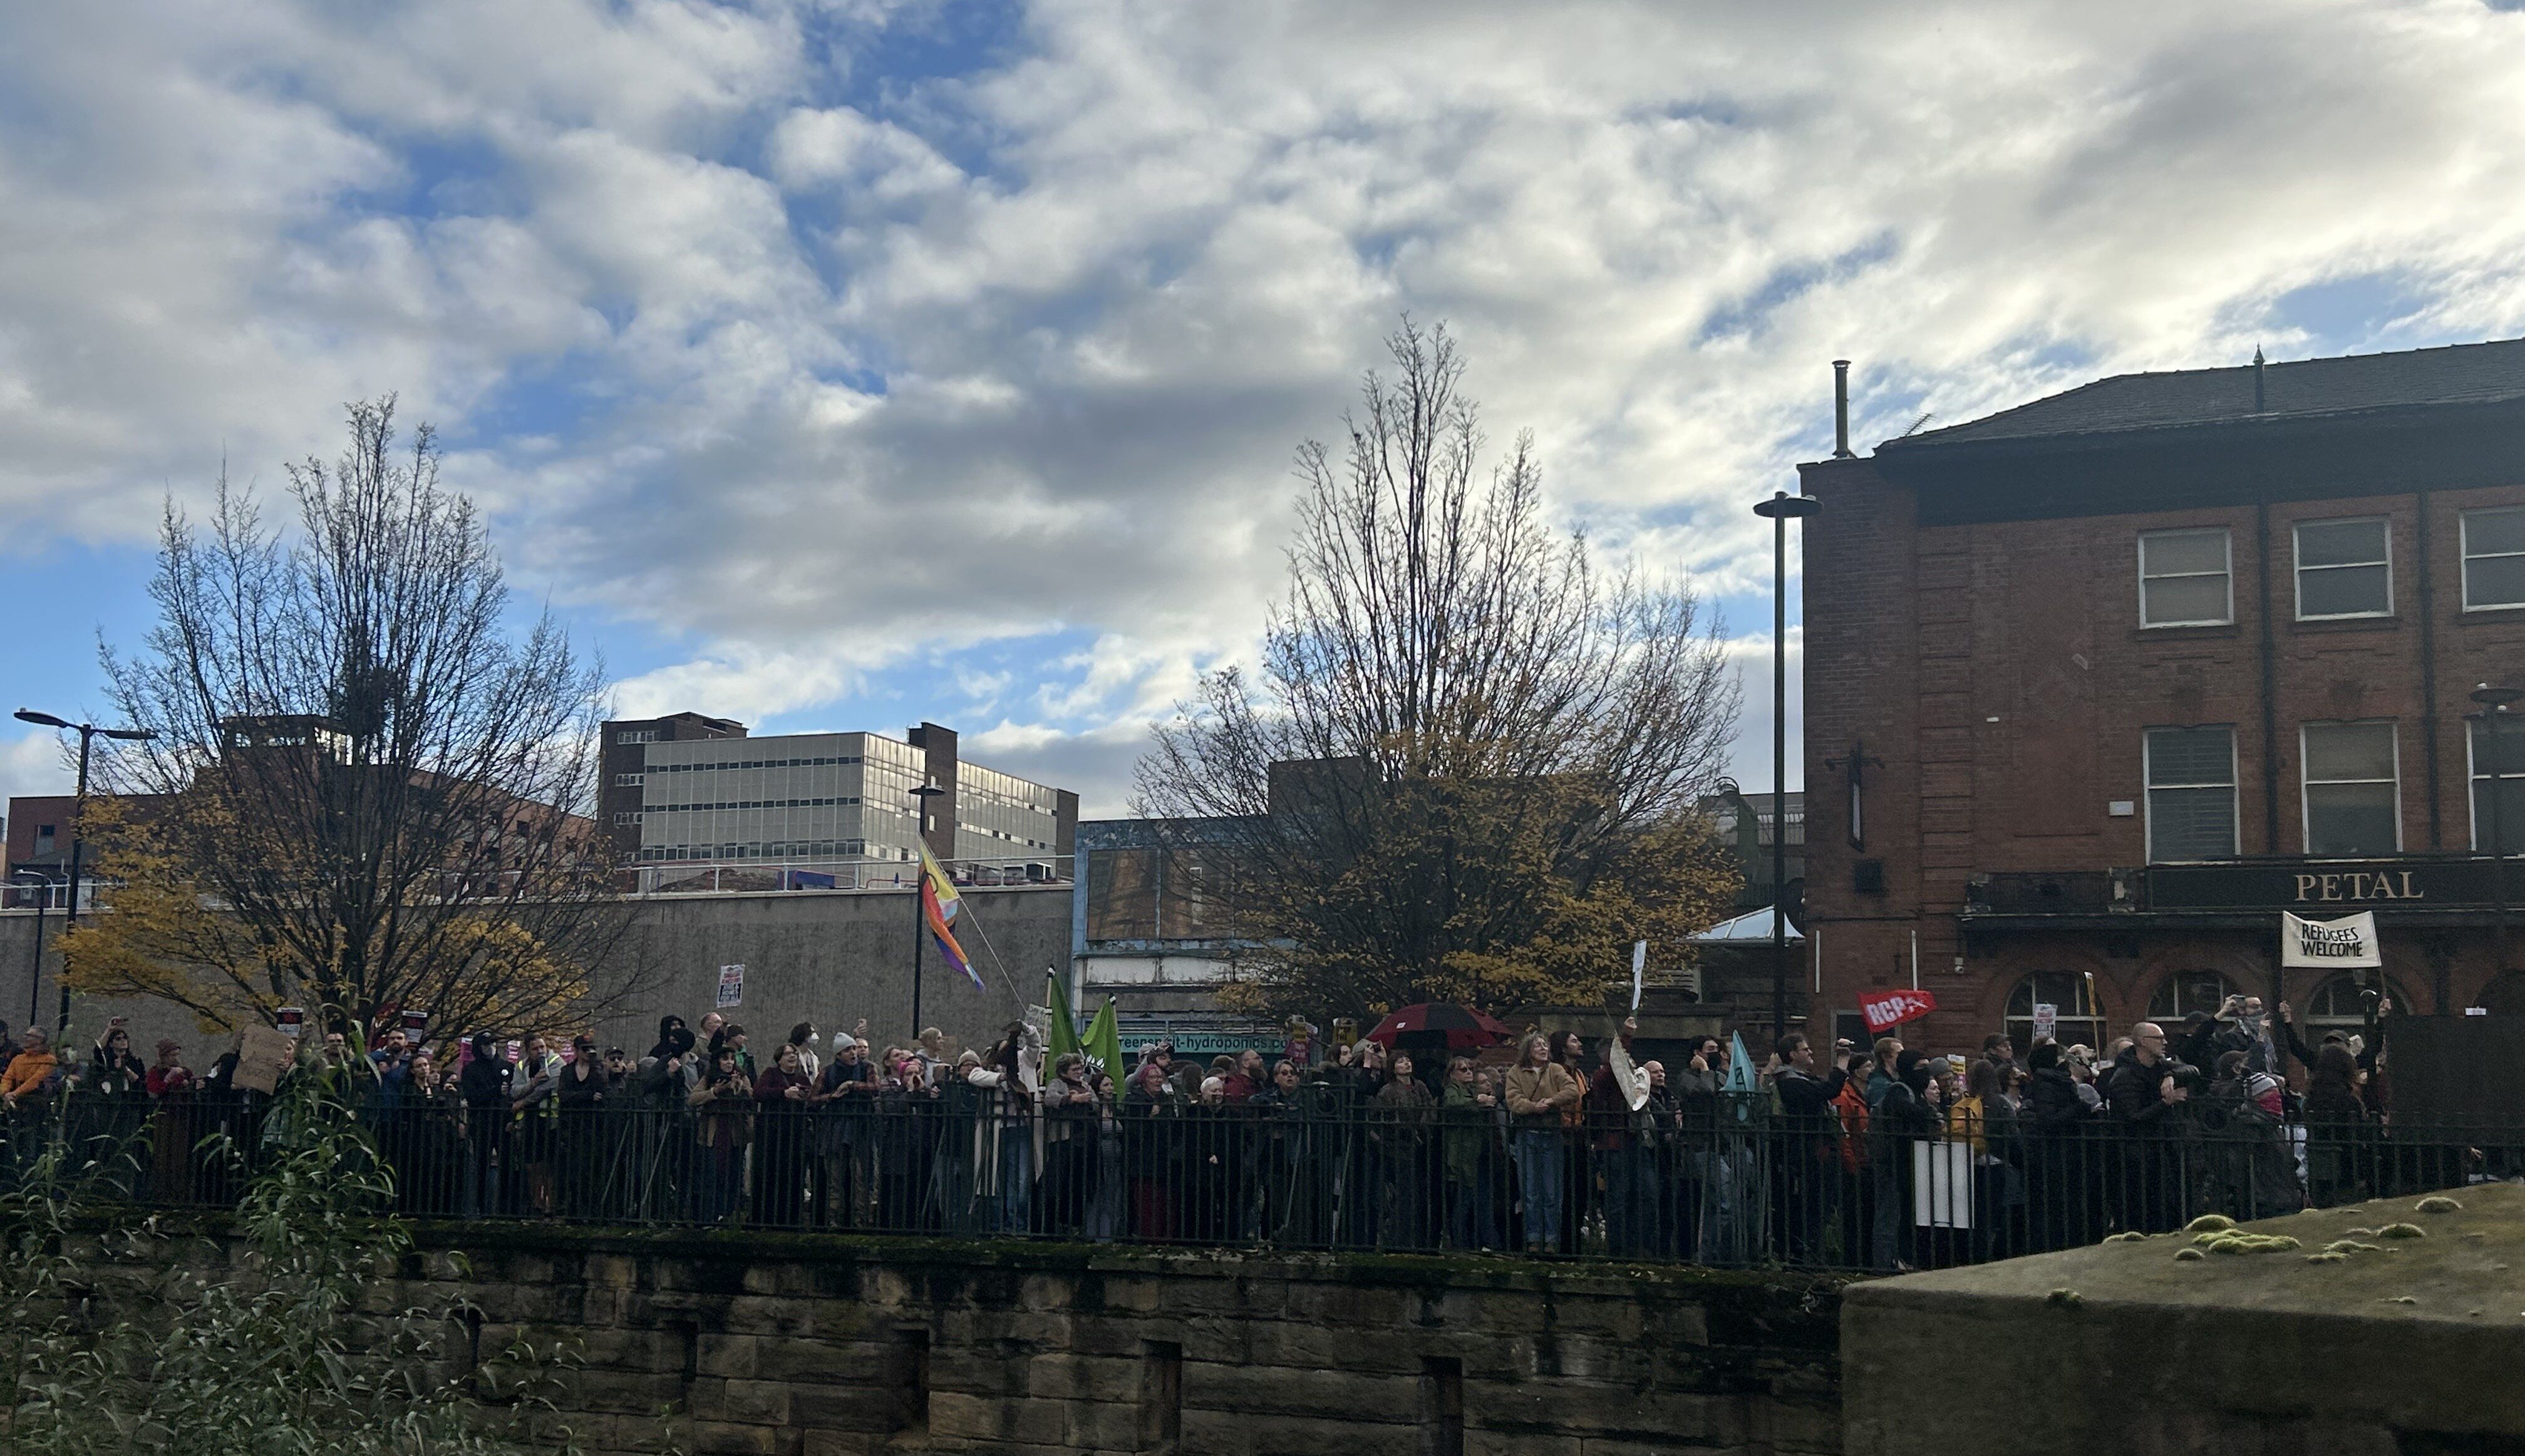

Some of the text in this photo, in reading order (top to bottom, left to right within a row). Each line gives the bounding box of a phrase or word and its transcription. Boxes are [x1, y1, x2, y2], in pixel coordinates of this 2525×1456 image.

[2295, 871, 2424, 901] PETAL
[2302, 924, 2359, 942] REFUGEES
[2301, 941, 2363, 957] WELCOME
[1866, 996, 1907, 1026] RCP
